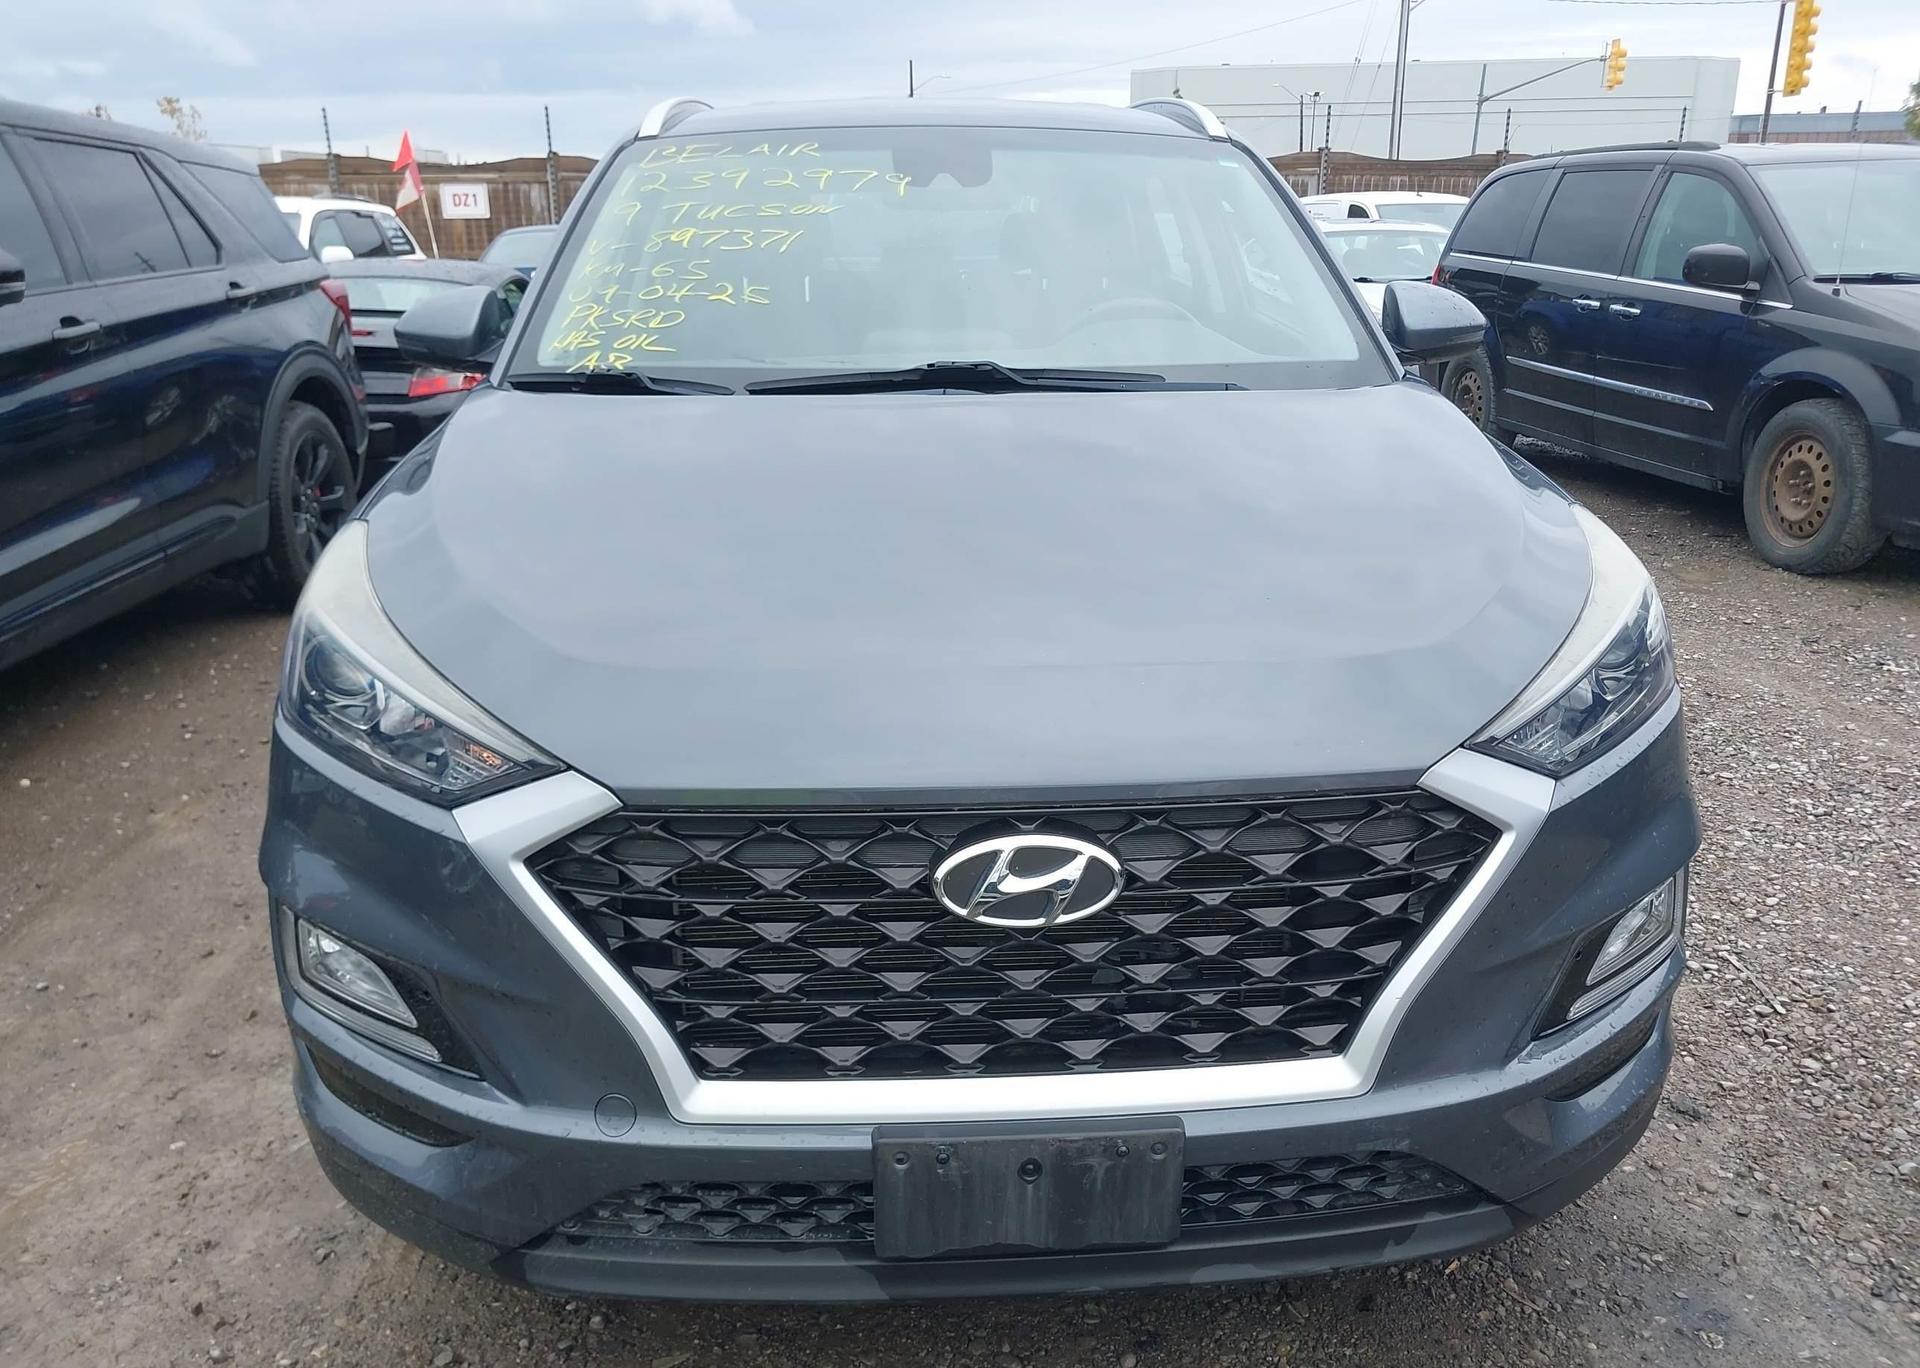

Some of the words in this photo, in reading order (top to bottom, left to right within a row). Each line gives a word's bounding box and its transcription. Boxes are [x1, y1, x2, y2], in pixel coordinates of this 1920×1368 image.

[640, 142, 820, 168] BELAIR
[452, 192, 478, 207] DZ1
[662, 202, 846, 223] TUCSON
